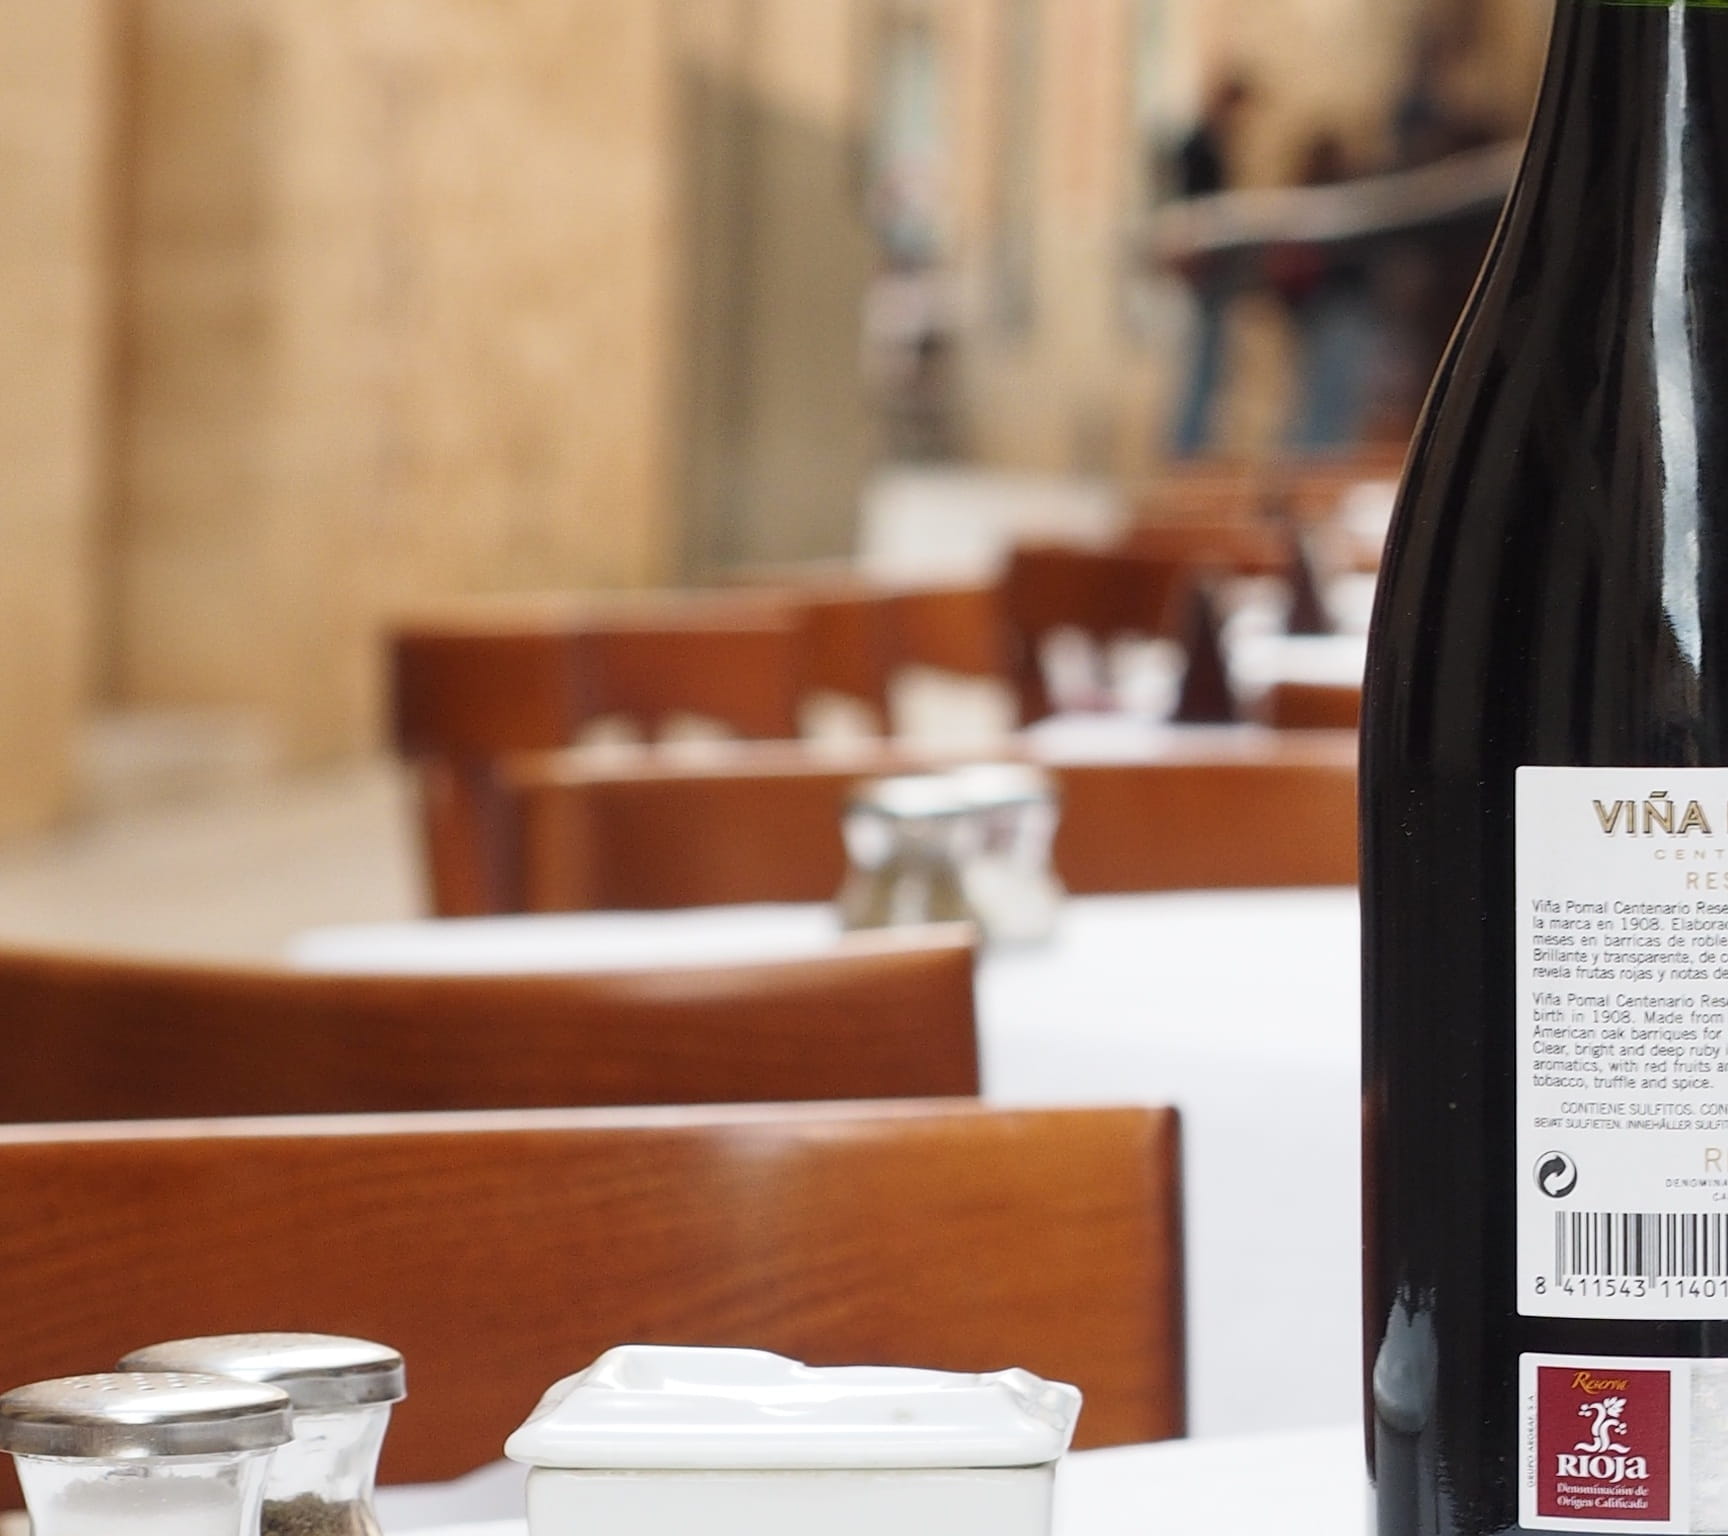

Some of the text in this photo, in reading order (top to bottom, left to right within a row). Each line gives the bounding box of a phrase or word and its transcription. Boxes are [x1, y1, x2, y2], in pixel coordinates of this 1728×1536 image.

[1592, 790, 1712, 835] VIÑA
[1532, 899, 1560, 913] Viña
[1566, 900, 1608, 913] Pomal
[1613, 901, 1690, 914] Centenario
[1533, 917, 1543, 929] la
[1550, 919, 1591, 930] marca
[1597, 920, 1613, 930] en
[1622, 917, 1664, 931] 1908.
[1533, 935, 1575, 946] meses
[1581, 935, 1597, 946] en
[1604, 935, 1661, 947] barricas
[1667, 935, 1685, 947] de
[1692, 935, 1728, 947] roble
[1533, 948, 1587, 962] Brillante
[1592, 952, 1599, 965] y
[1604, 951, 1693, 965] transparente,
[1700, 951, 1716, 963] de
[1532, 966, 1570, 978] revela
[1576, 966, 1615, 979] frutas
[1620, 968, 1653, 983] rojas
[1658, 970, 1666, 983] y
[1670, 968, 1708, 979] notas
[1532, 993, 1560, 1005] Viña
[1567, 993, 1609, 1007] Pomal
[1616, 994, 1694, 1008] Centenario
[1533, 1009, 1563, 1022] birth
[1572, 1011, 1584, 1022] in
[1593, 1010, 1635, 1023] 1908.
[1644, 1011, 1683, 1024] Made
[1691, 1011, 1724, 1023] from
[1533, 1025, 1596, 1039] American
[1601, 1027, 1625, 1039] oak
[1631, 1027, 1697, 1041] barriques
[1703, 1027, 1721, 1040] for
[1533, 1041, 1569, 1055] Clear,
[1575, 1043, 1614, 1058] bright
[1620, 1044, 1644, 1056] and
[1651, 1044, 1684, 1058] deep
[1690, 1047, 1720, 1058] ruby
[1533, 1059, 1603, 1073] aromatics,
[1609, 1060, 1638, 1072] with
[1645, 1060, 1666, 1073] red
[1674, 1060, 1711, 1073] fruits
[1533, 1075, 1714, 1091] tobacco, truffle and spice.
[1561, 1102, 1625, 1115] CONTIENE
[1629, 1103, 1693, 1116] SULFITOS.
[1534, 1276, 1546, 1294] 8
[1563, 1279, 1645, 1297] 411543
[1557, 1483, 1648, 1496] Denominación de
[1557, 1496, 1648, 1509] Origen Calificada
